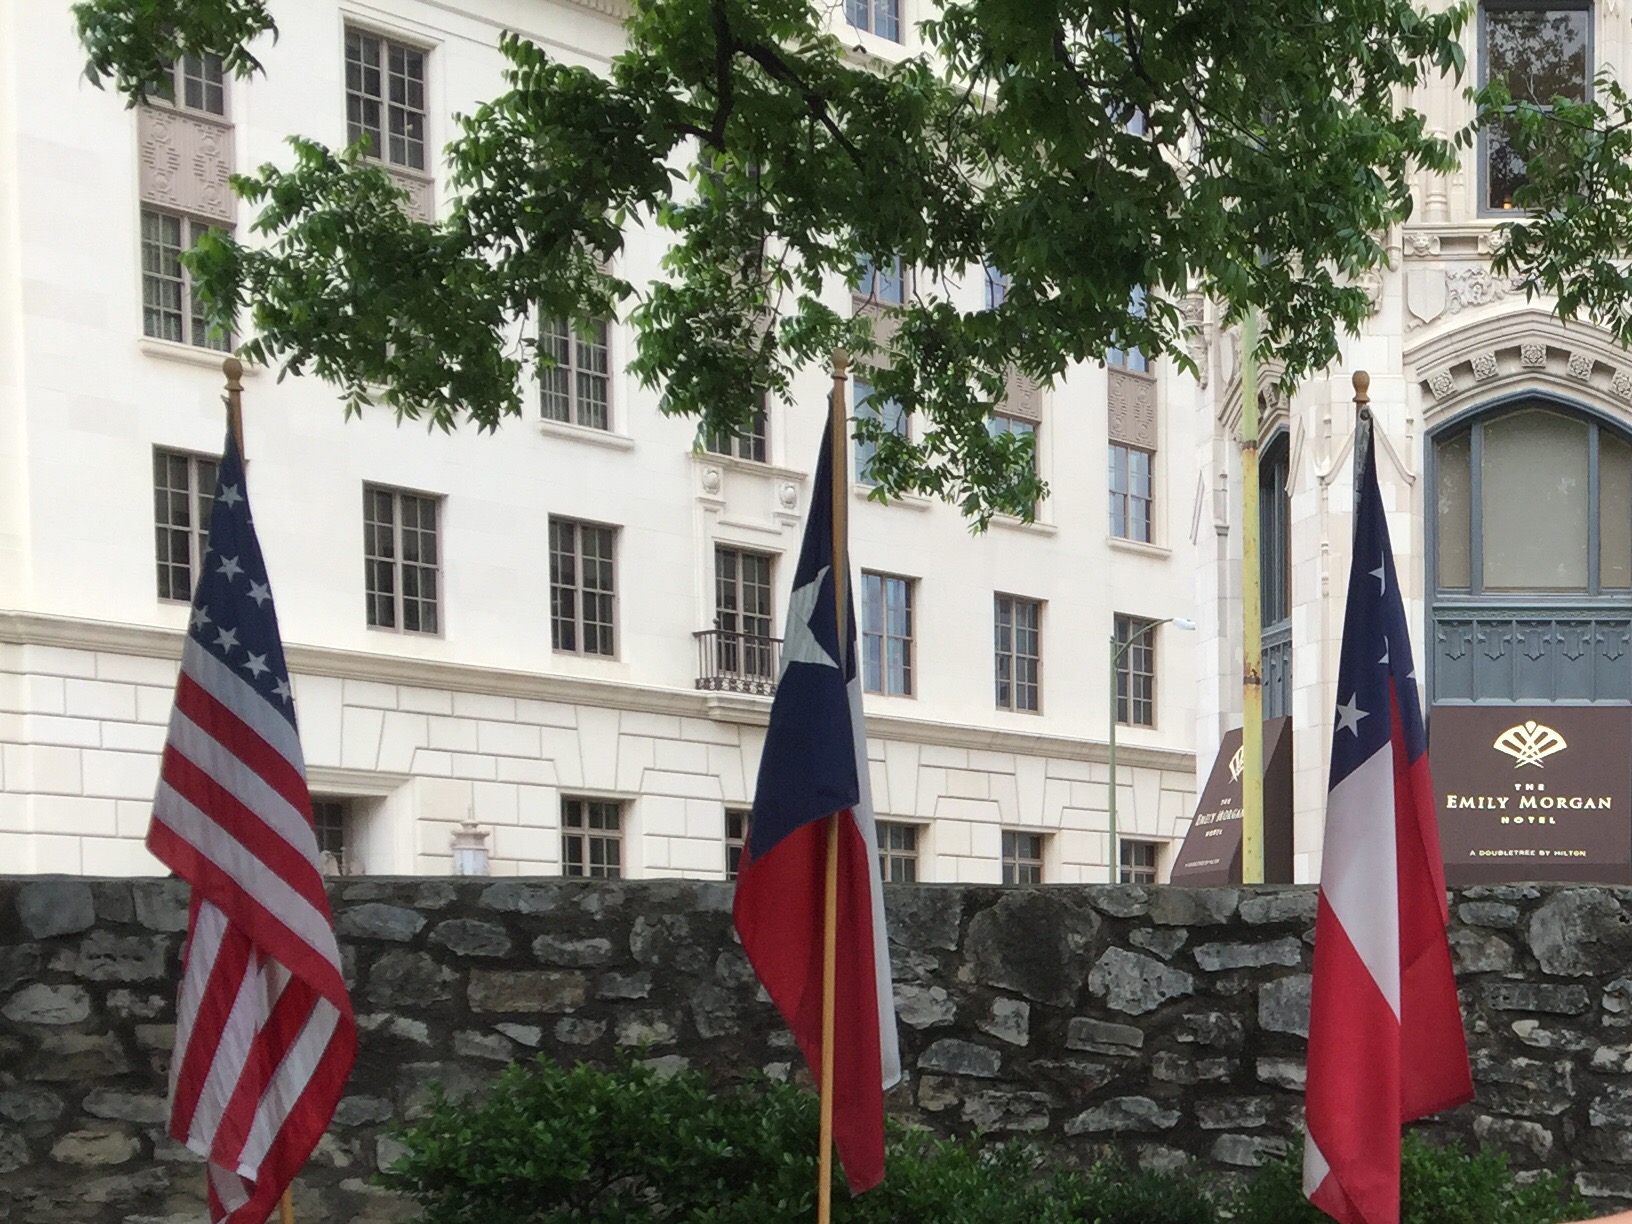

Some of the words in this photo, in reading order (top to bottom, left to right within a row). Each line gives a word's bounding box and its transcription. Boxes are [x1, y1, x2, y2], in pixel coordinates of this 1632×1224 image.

[1514, 783, 1545, 791] THE
[1446, 795, 1510, 810] EMILY
[1519, 796, 1612, 810] MORGAN
[1500, 816, 1556, 825] HOTEL
[1479, 850, 1536, 858] DOUBLETREE
[1539, 850, 1551, 858] BY
[1554, 850, 1587, 858] HILTON
